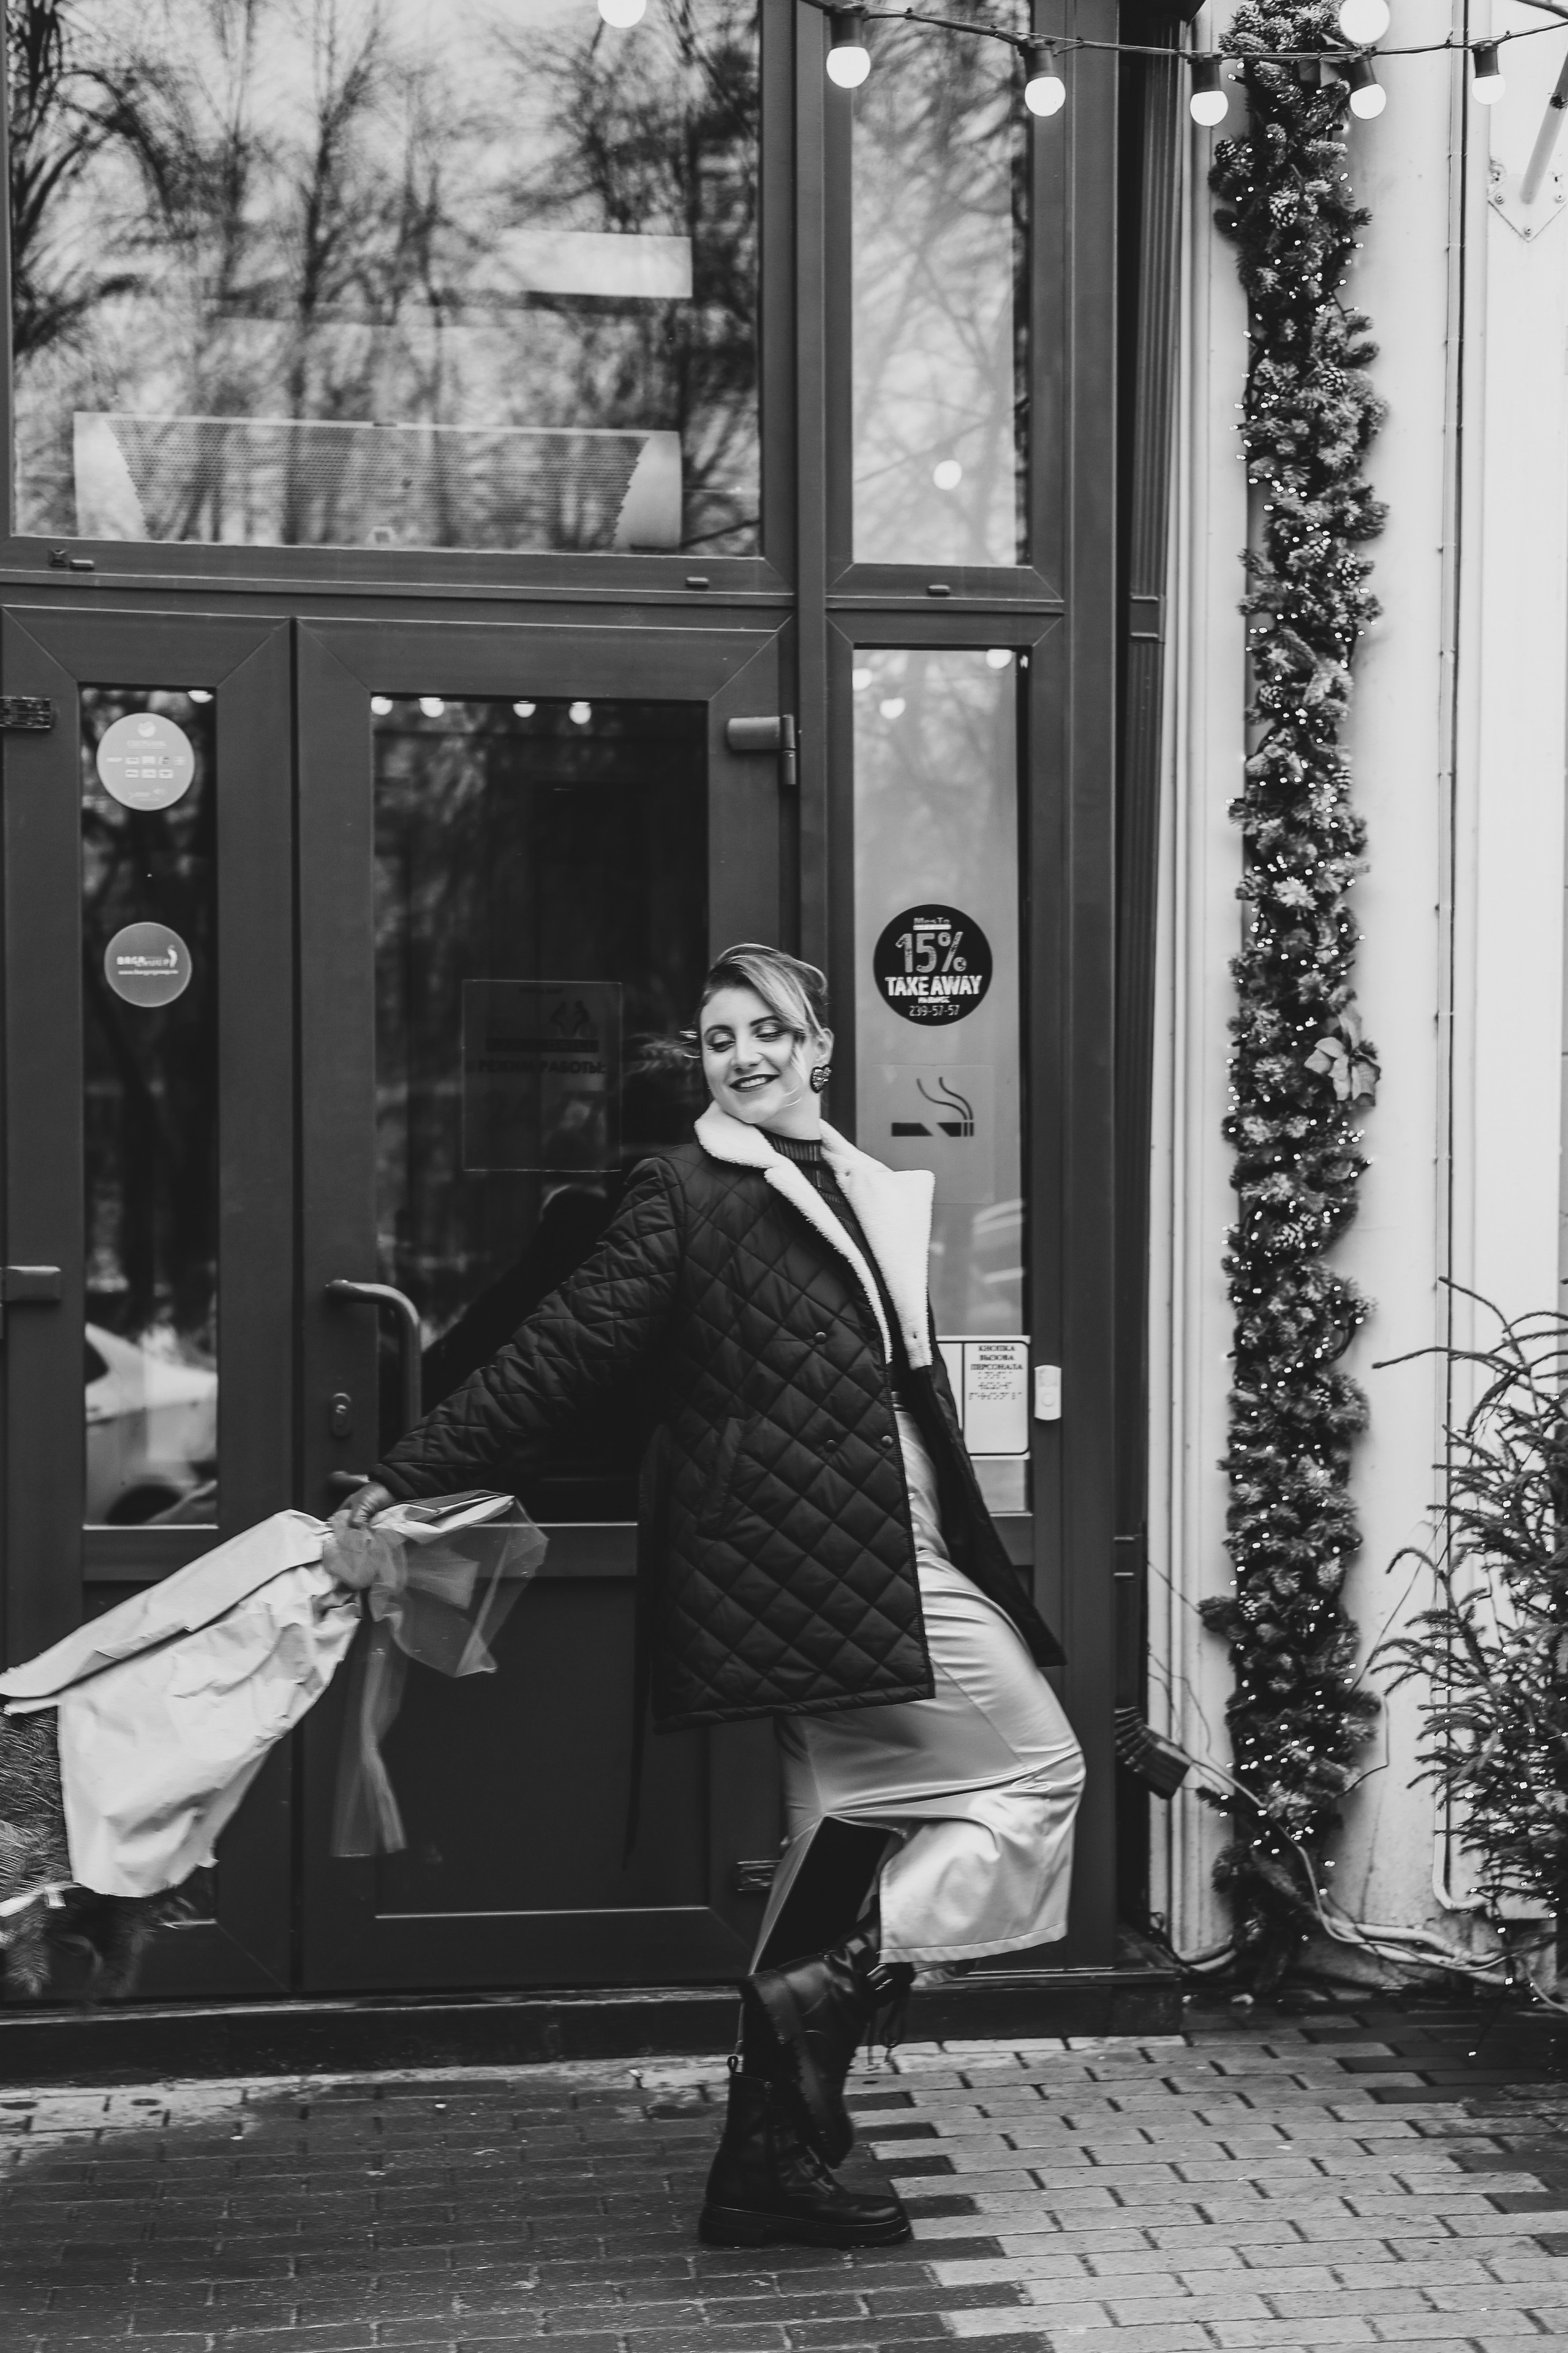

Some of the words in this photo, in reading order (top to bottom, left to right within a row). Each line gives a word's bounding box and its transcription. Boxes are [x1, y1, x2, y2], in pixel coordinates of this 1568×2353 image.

[895, 931, 967, 973] 15%
[884, 976, 929, 996] TAKE
[930, 975, 982, 995] AWAY
[908, 1005, 960, 1016] 239-57-57
